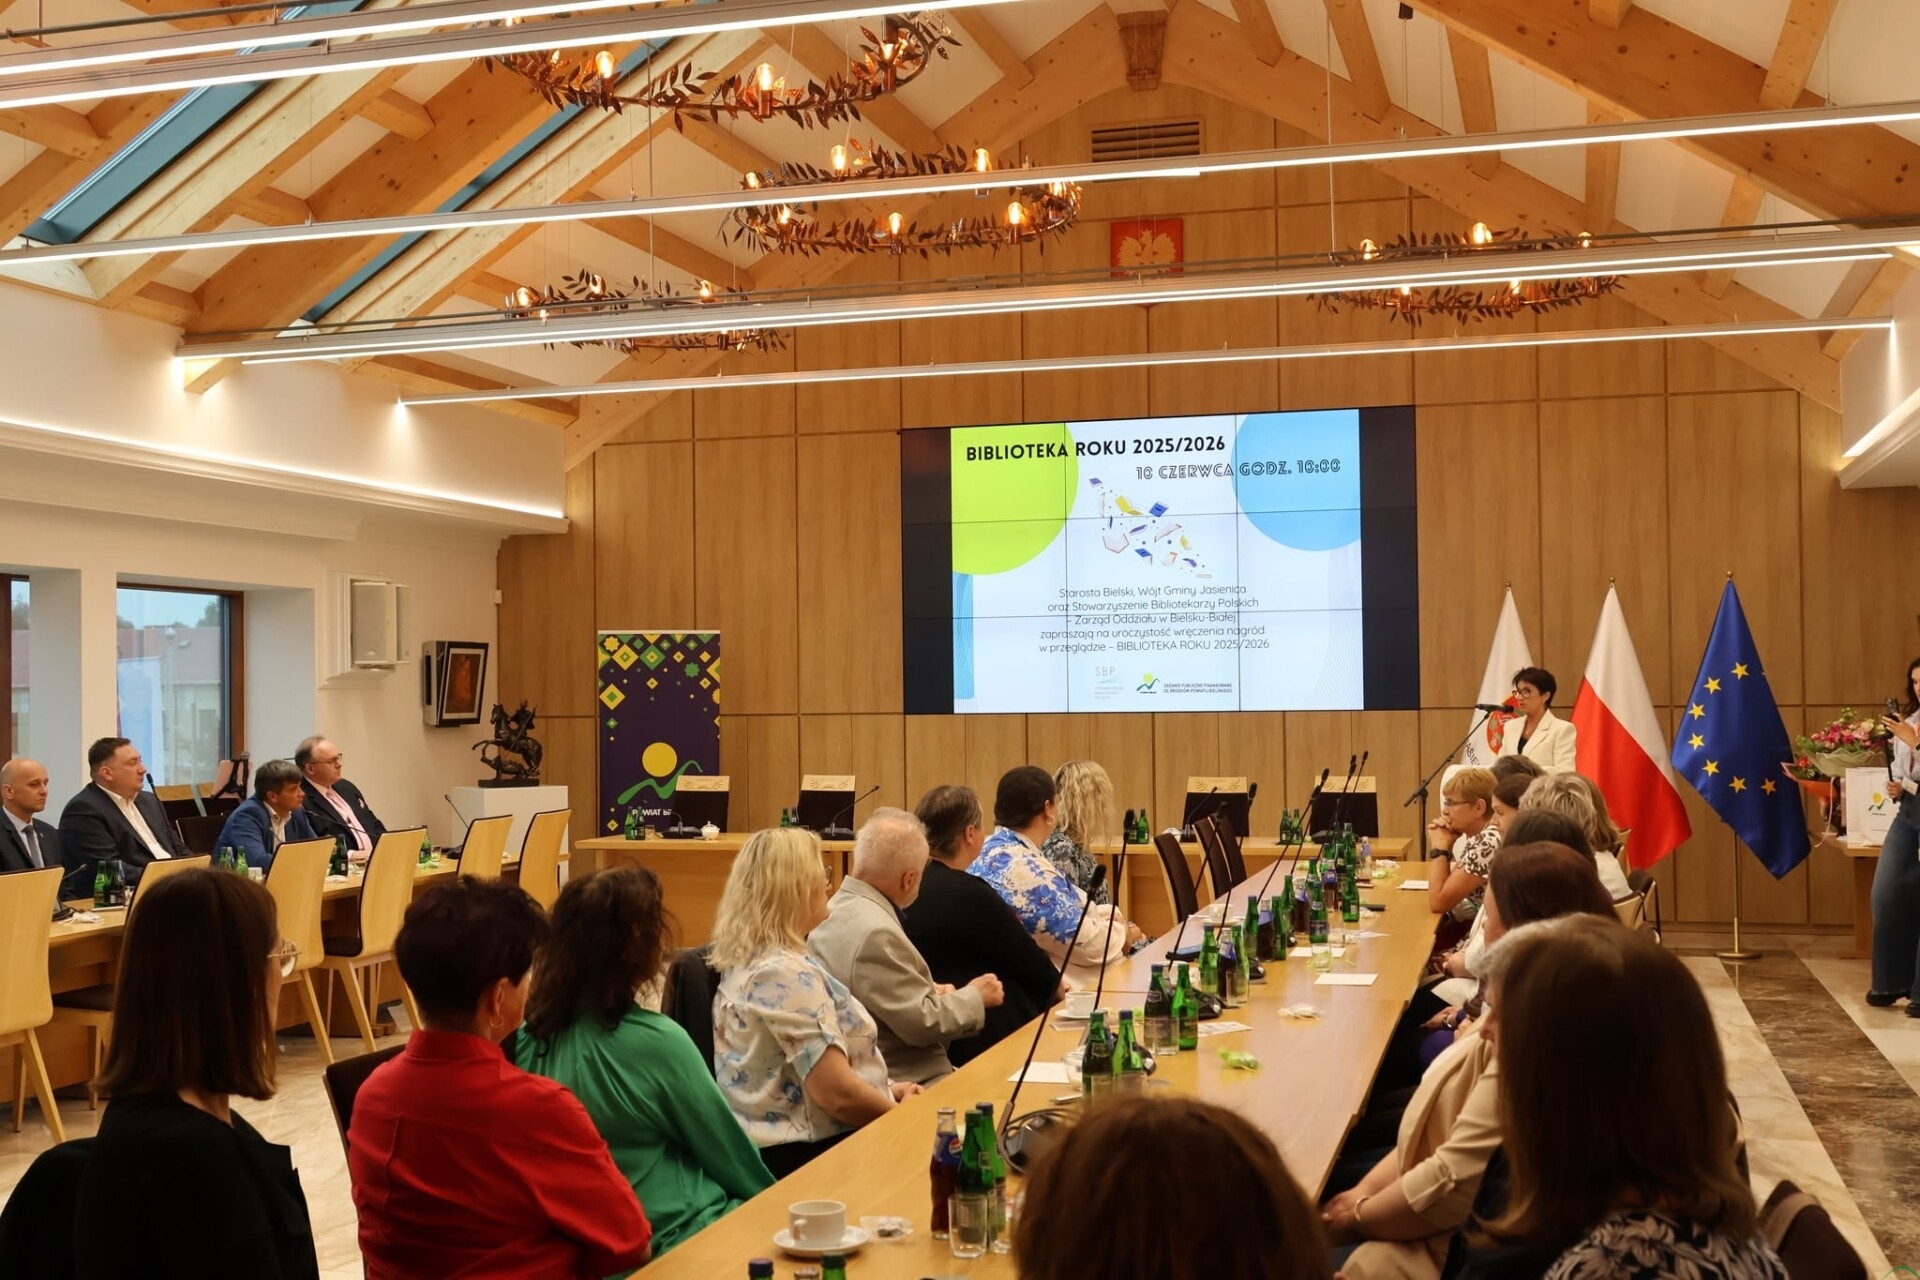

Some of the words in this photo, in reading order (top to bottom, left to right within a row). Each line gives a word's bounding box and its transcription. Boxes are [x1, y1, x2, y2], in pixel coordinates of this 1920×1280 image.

[966, 443, 1069, 461] BIBLIOTEKA
[1075, 440, 1126, 457] ROKU
[1133, 436, 1226, 455] 2025/2026
[1136, 466, 1153, 480] 10
[1158, 463, 1234, 479] CZERWCA
[1239, 460, 1292, 476] GODZ.
[1297, 458, 1341, 474] 10:00
[1059, 588, 1101, 598] Starosta
[1103, 586, 1136, 598] Bielski,
[1137, 586, 1161, 598] Wójt
[1163, 585, 1197, 597] Gminy
[1199, 584, 1247, 595] Jasienica
[1047, 603, 1070, 612] oraz
[1072, 601, 1149, 613] Stowarzyszenie
[1151, 598, 1216, 611] Bibliotekarzy
[1218, 597, 1259, 608] Polskich
[1075, 614, 1111, 626] Zarząd
[1112, 613, 1157, 624] Oddziału
[1170, 611, 1237, 624] Bielsku-Białej
[1040, 628, 1094, 641] zapraszają
[1096, 629, 1109, 638] na
[1111, 627, 1172, 640] uroczystość
[1173, 626, 1225, 638] wręczenia
[1226, 624, 1266, 638] nagród
[1039, 644, 1047, 652] w
[1049, 641, 1107, 654] przeglądzie
[1116, 640, 1178, 651] BIBLIOTEKA
[1179, 639, 1211, 650] ROKU
[1213, 638, 1271, 650] 2025/2026
[1095, 666, 1116, 677] SBP
[632, 808, 662, 816] PWIAT
